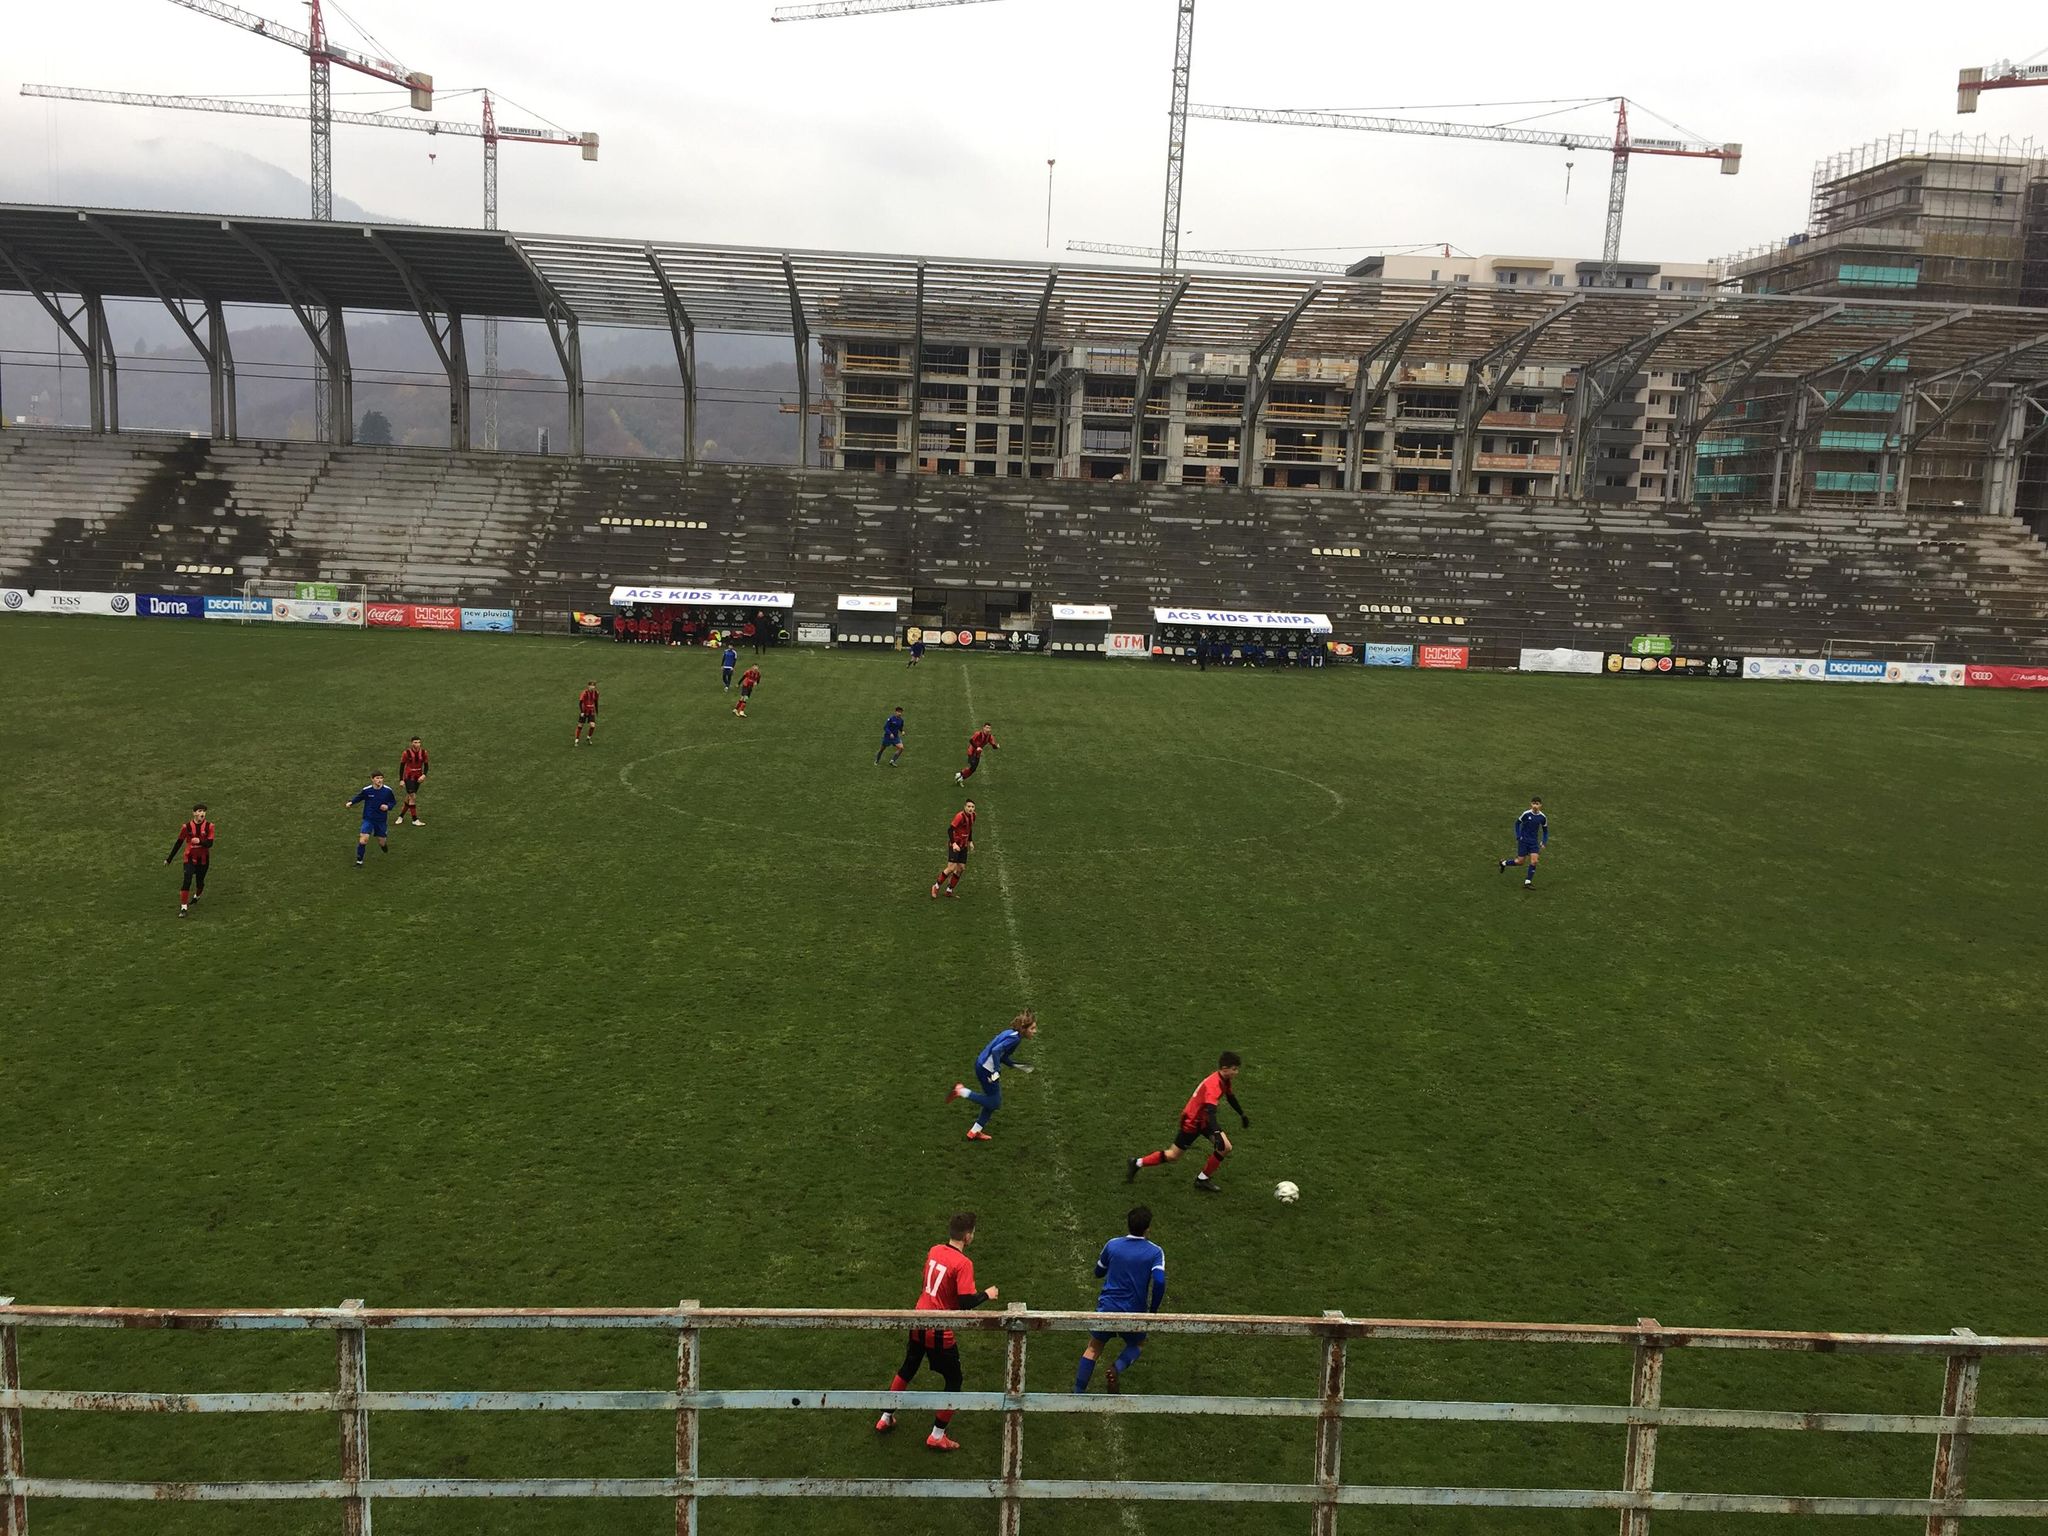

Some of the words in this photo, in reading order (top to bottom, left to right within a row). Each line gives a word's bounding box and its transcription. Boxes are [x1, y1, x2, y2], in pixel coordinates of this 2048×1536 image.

[50, 596, 80, 605] TESS
[626, 590, 663, 599] ACS
[668, 591, 712, 600] KIDS
[208, 599, 267, 611] DECATHLON
[415, 607, 455, 621] HMK
[1167, 612, 1202, 620] ACS
[1207, 613, 1249, 622] KIDS
[1114, 635, 1143, 650] GTM
[1425, 648, 1462, 660] HMK
[1830, 663, 1883, 674] DECATHLON
[925, 1259, 947, 1297] 17
